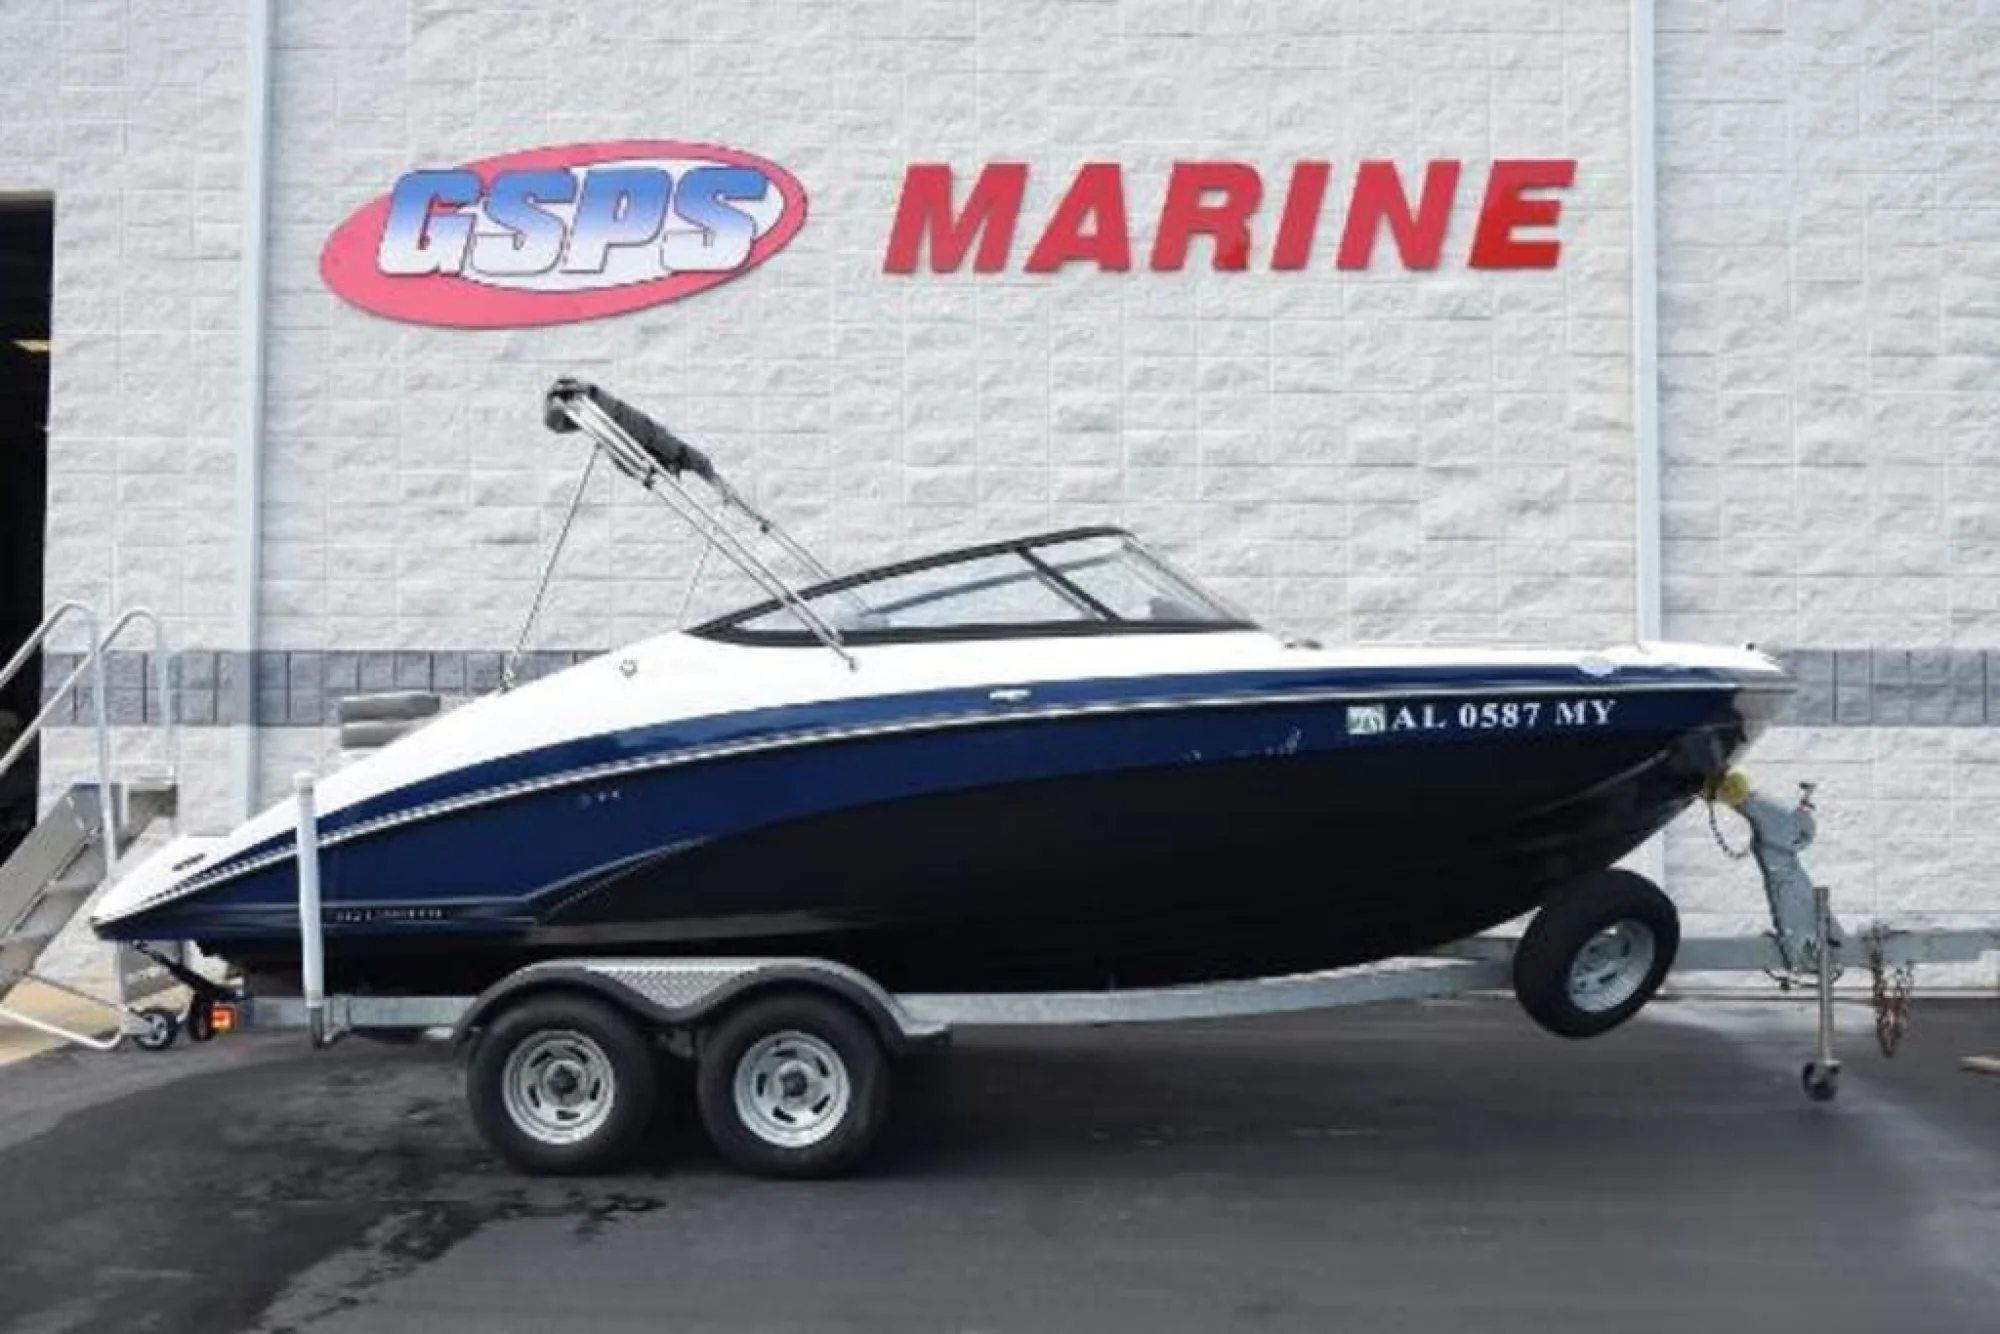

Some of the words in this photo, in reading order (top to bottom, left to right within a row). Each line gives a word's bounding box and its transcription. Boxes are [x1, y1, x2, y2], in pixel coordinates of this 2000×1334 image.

[377, 166, 769, 276] GSPS
[883, 160, 1577, 274] MARINE
[1391, 705, 1447, 730] AL
[1458, 702, 1541, 729] 0587
[1555, 699, 1616, 726] MY
